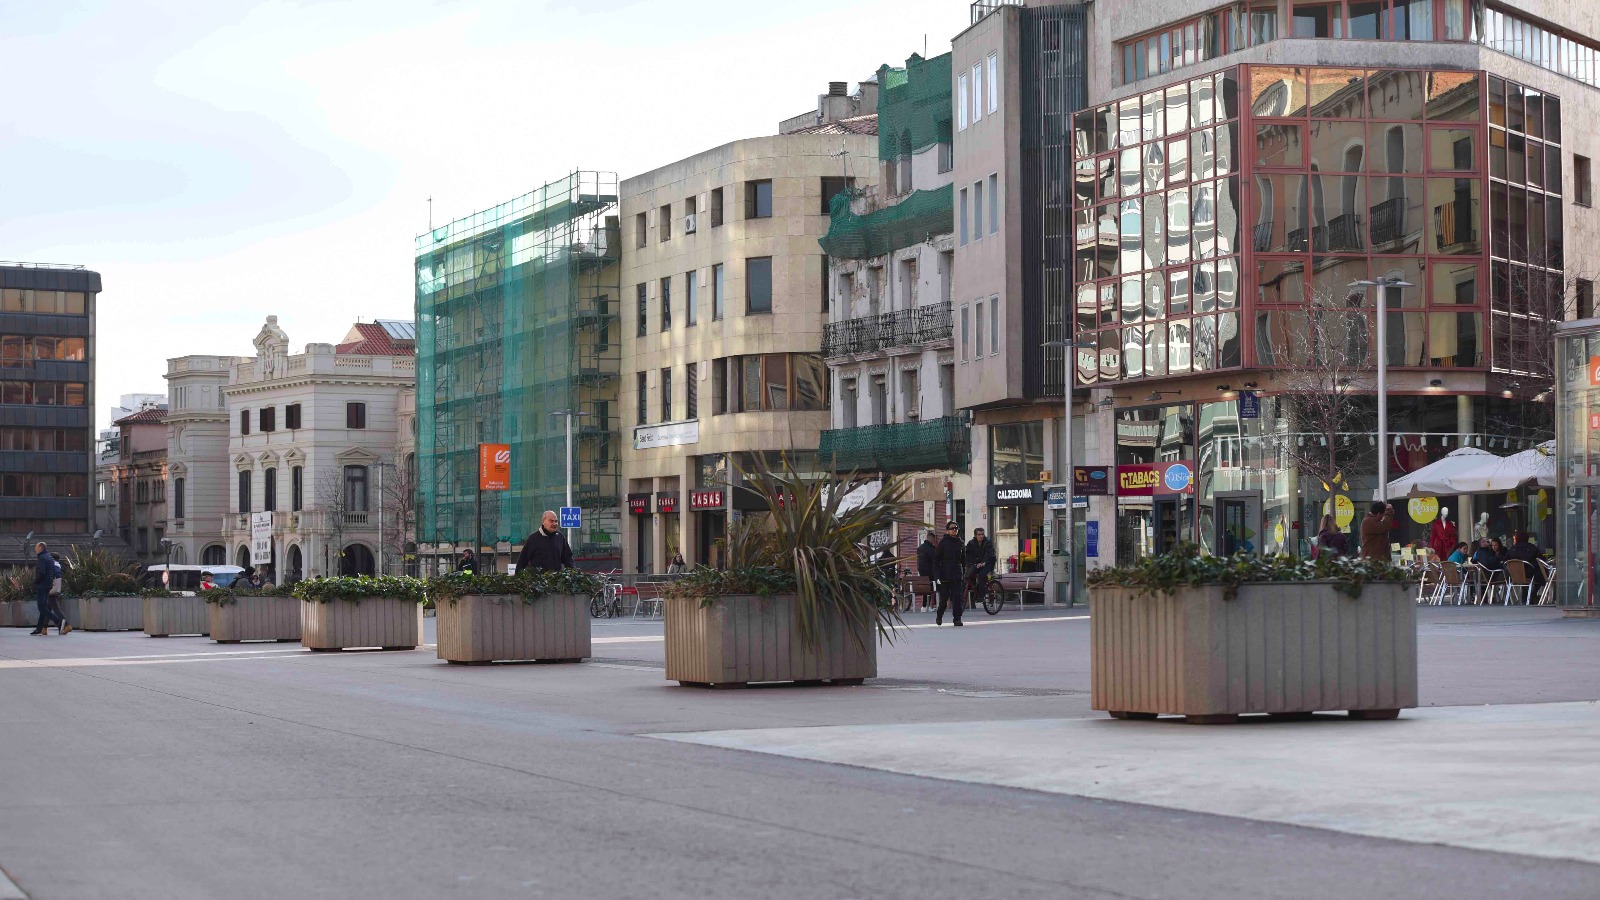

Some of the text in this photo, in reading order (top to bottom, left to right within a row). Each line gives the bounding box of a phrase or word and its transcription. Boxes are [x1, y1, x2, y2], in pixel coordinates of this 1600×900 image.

[1128, 470, 1160, 485] TABACS
[1567, 458, 1576, 515] Metro
[691, 493, 720, 506] CASAS
[997, 489, 1032, 500] CALZEDONIA
[658, 498, 674, 506] CASAS
